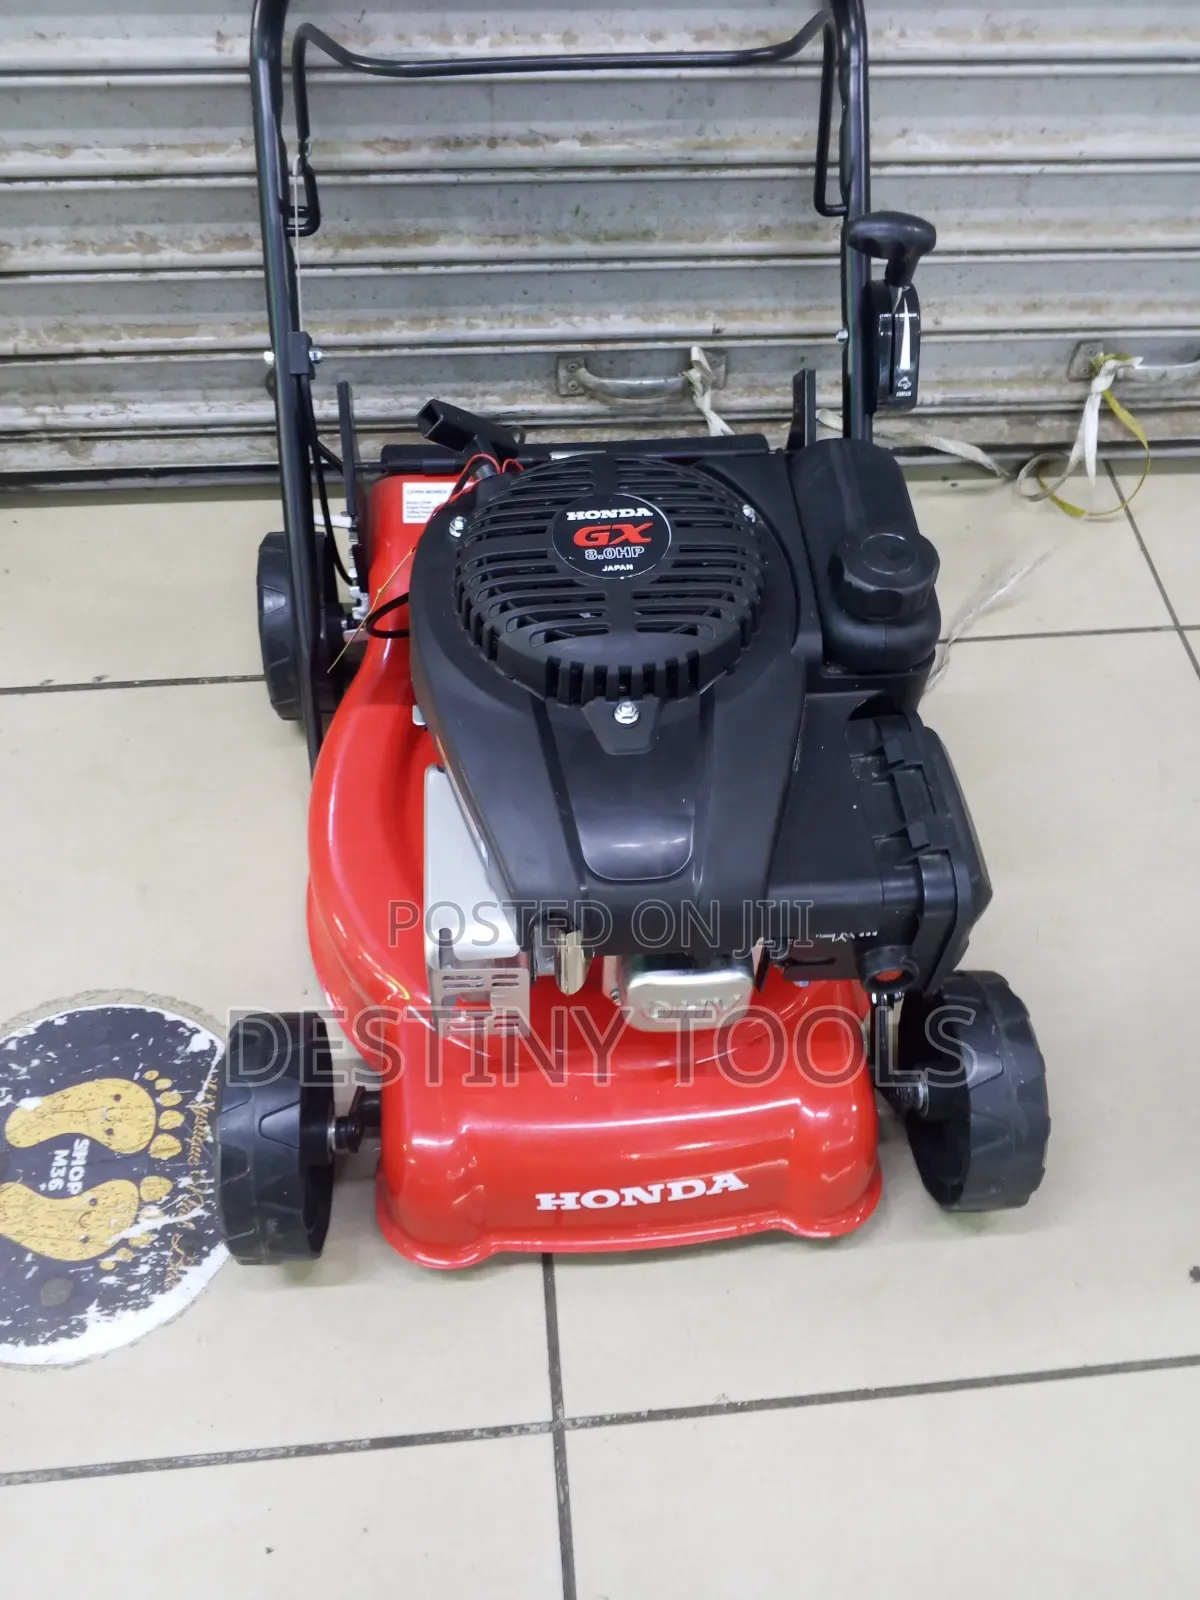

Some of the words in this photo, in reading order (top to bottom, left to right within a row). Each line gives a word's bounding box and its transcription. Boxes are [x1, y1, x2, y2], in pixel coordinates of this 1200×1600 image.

[566, 507, 654, 520] HONDA
[573, 521, 654, 547] GX
[585, 546, 645, 560] 8.0HP
[602, 563, 634, 572] JAPAN
[47, 1149, 70, 1191] M36
[66, 1138, 90, 1195] SHOP
[535, 1172, 749, 1211] HONDA
